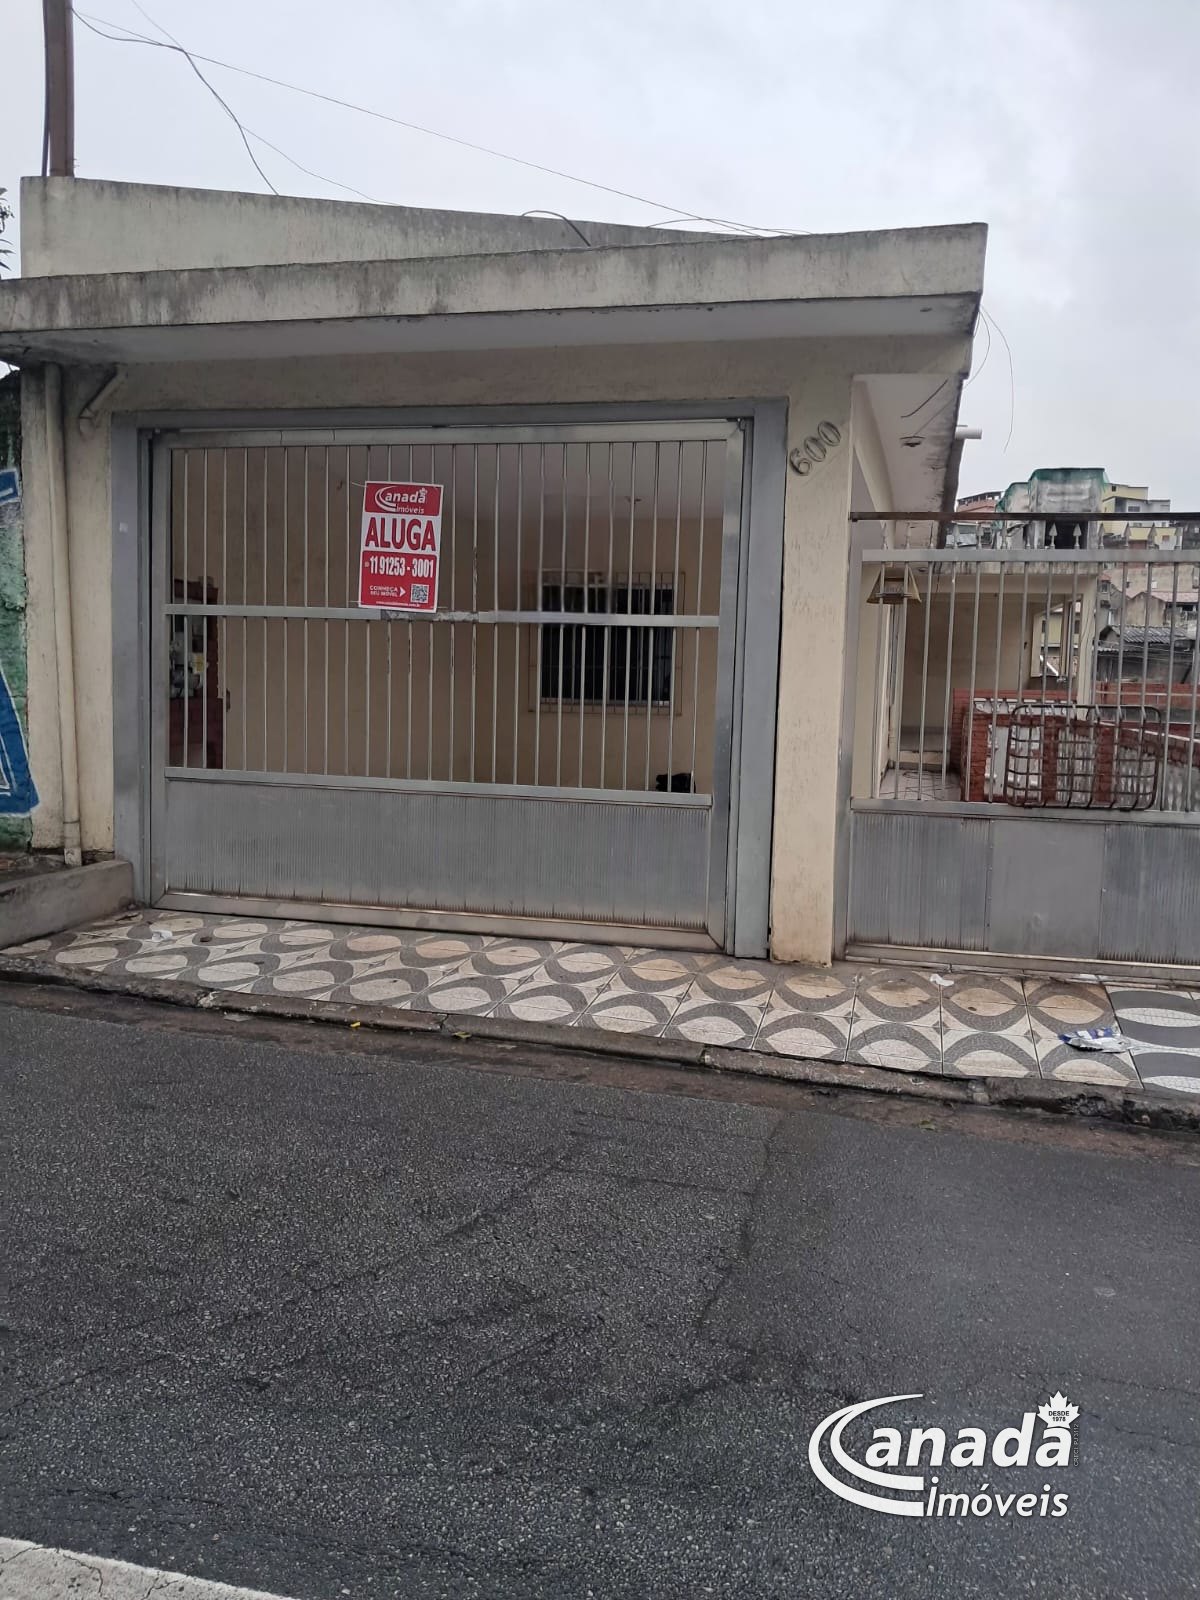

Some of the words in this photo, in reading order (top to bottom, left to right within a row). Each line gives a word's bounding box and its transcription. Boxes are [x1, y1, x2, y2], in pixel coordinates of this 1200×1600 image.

[788, 420, 841, 476] 600
[365, 517, 436, 551] ALUGA
[379, 556, 405, 576] 91253
[412, 558, 434, 578] 3001
